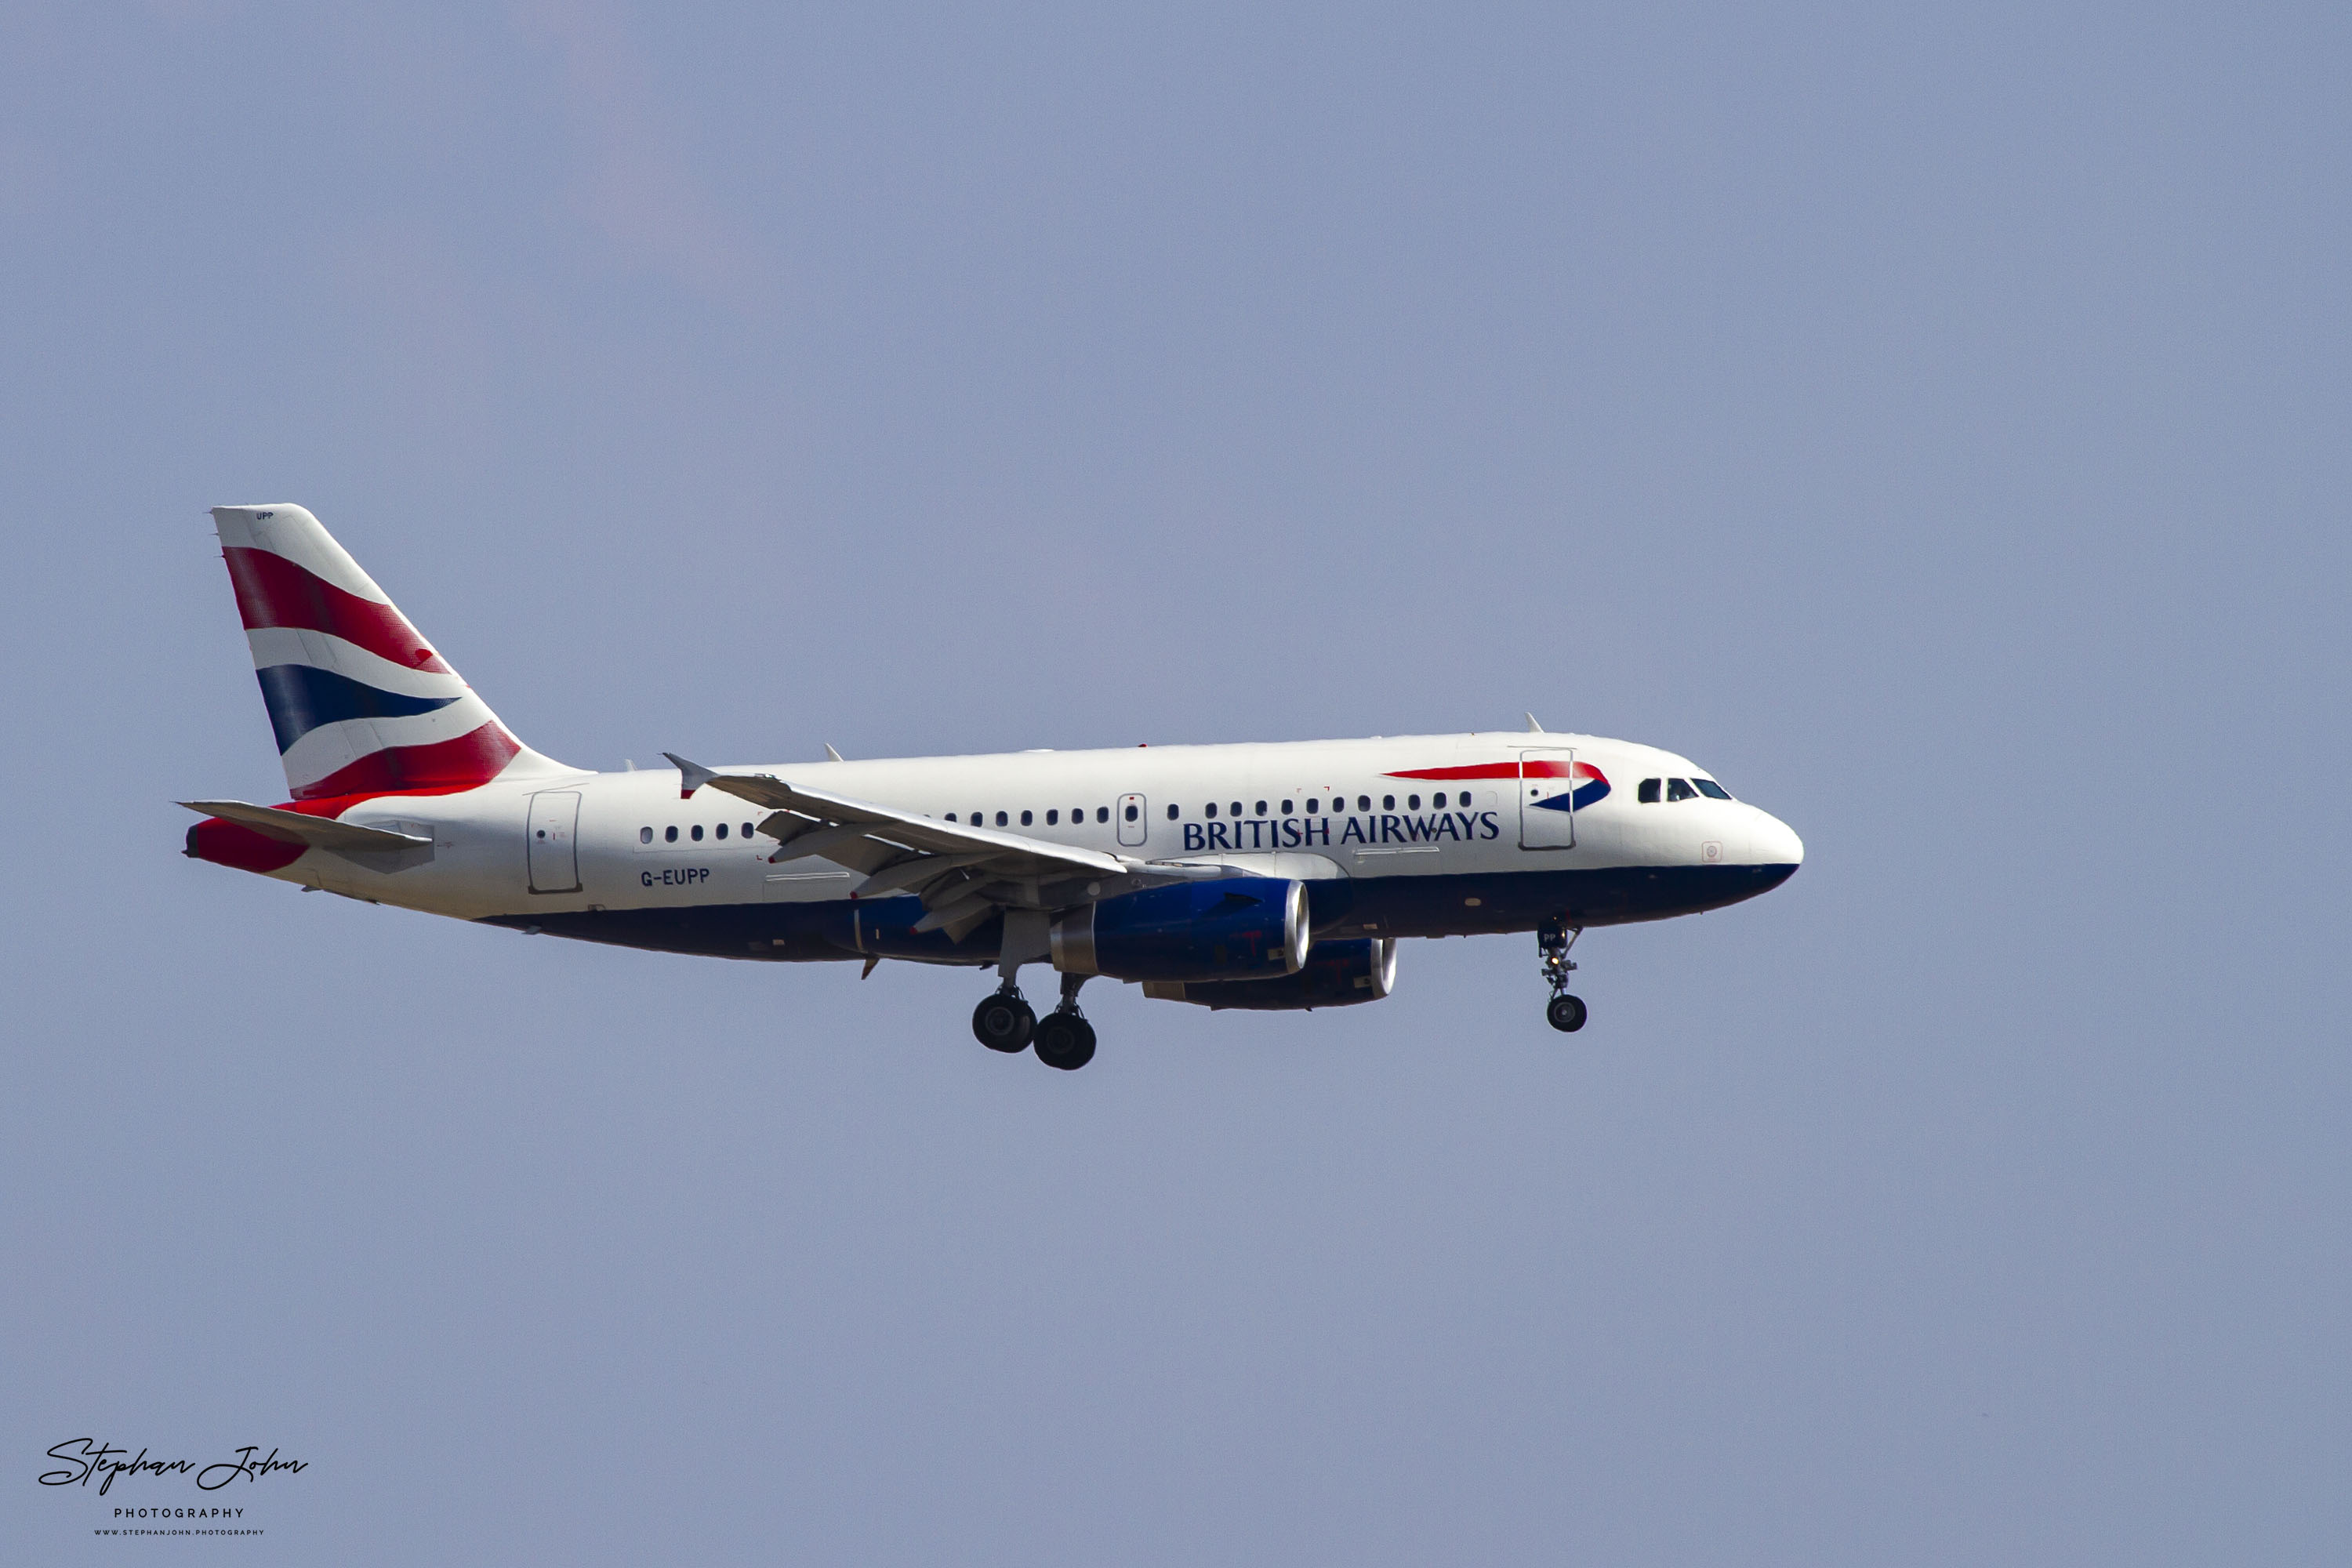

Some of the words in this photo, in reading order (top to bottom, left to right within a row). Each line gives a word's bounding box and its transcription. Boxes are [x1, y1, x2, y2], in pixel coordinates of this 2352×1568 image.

[256, 511, 274, 520] UPP
[1183, 817, 1330, 851] BRITISH
[1340, 811, 1500, 845] AIRWAYS
[641, 868, 710, 887] G-EUPP
